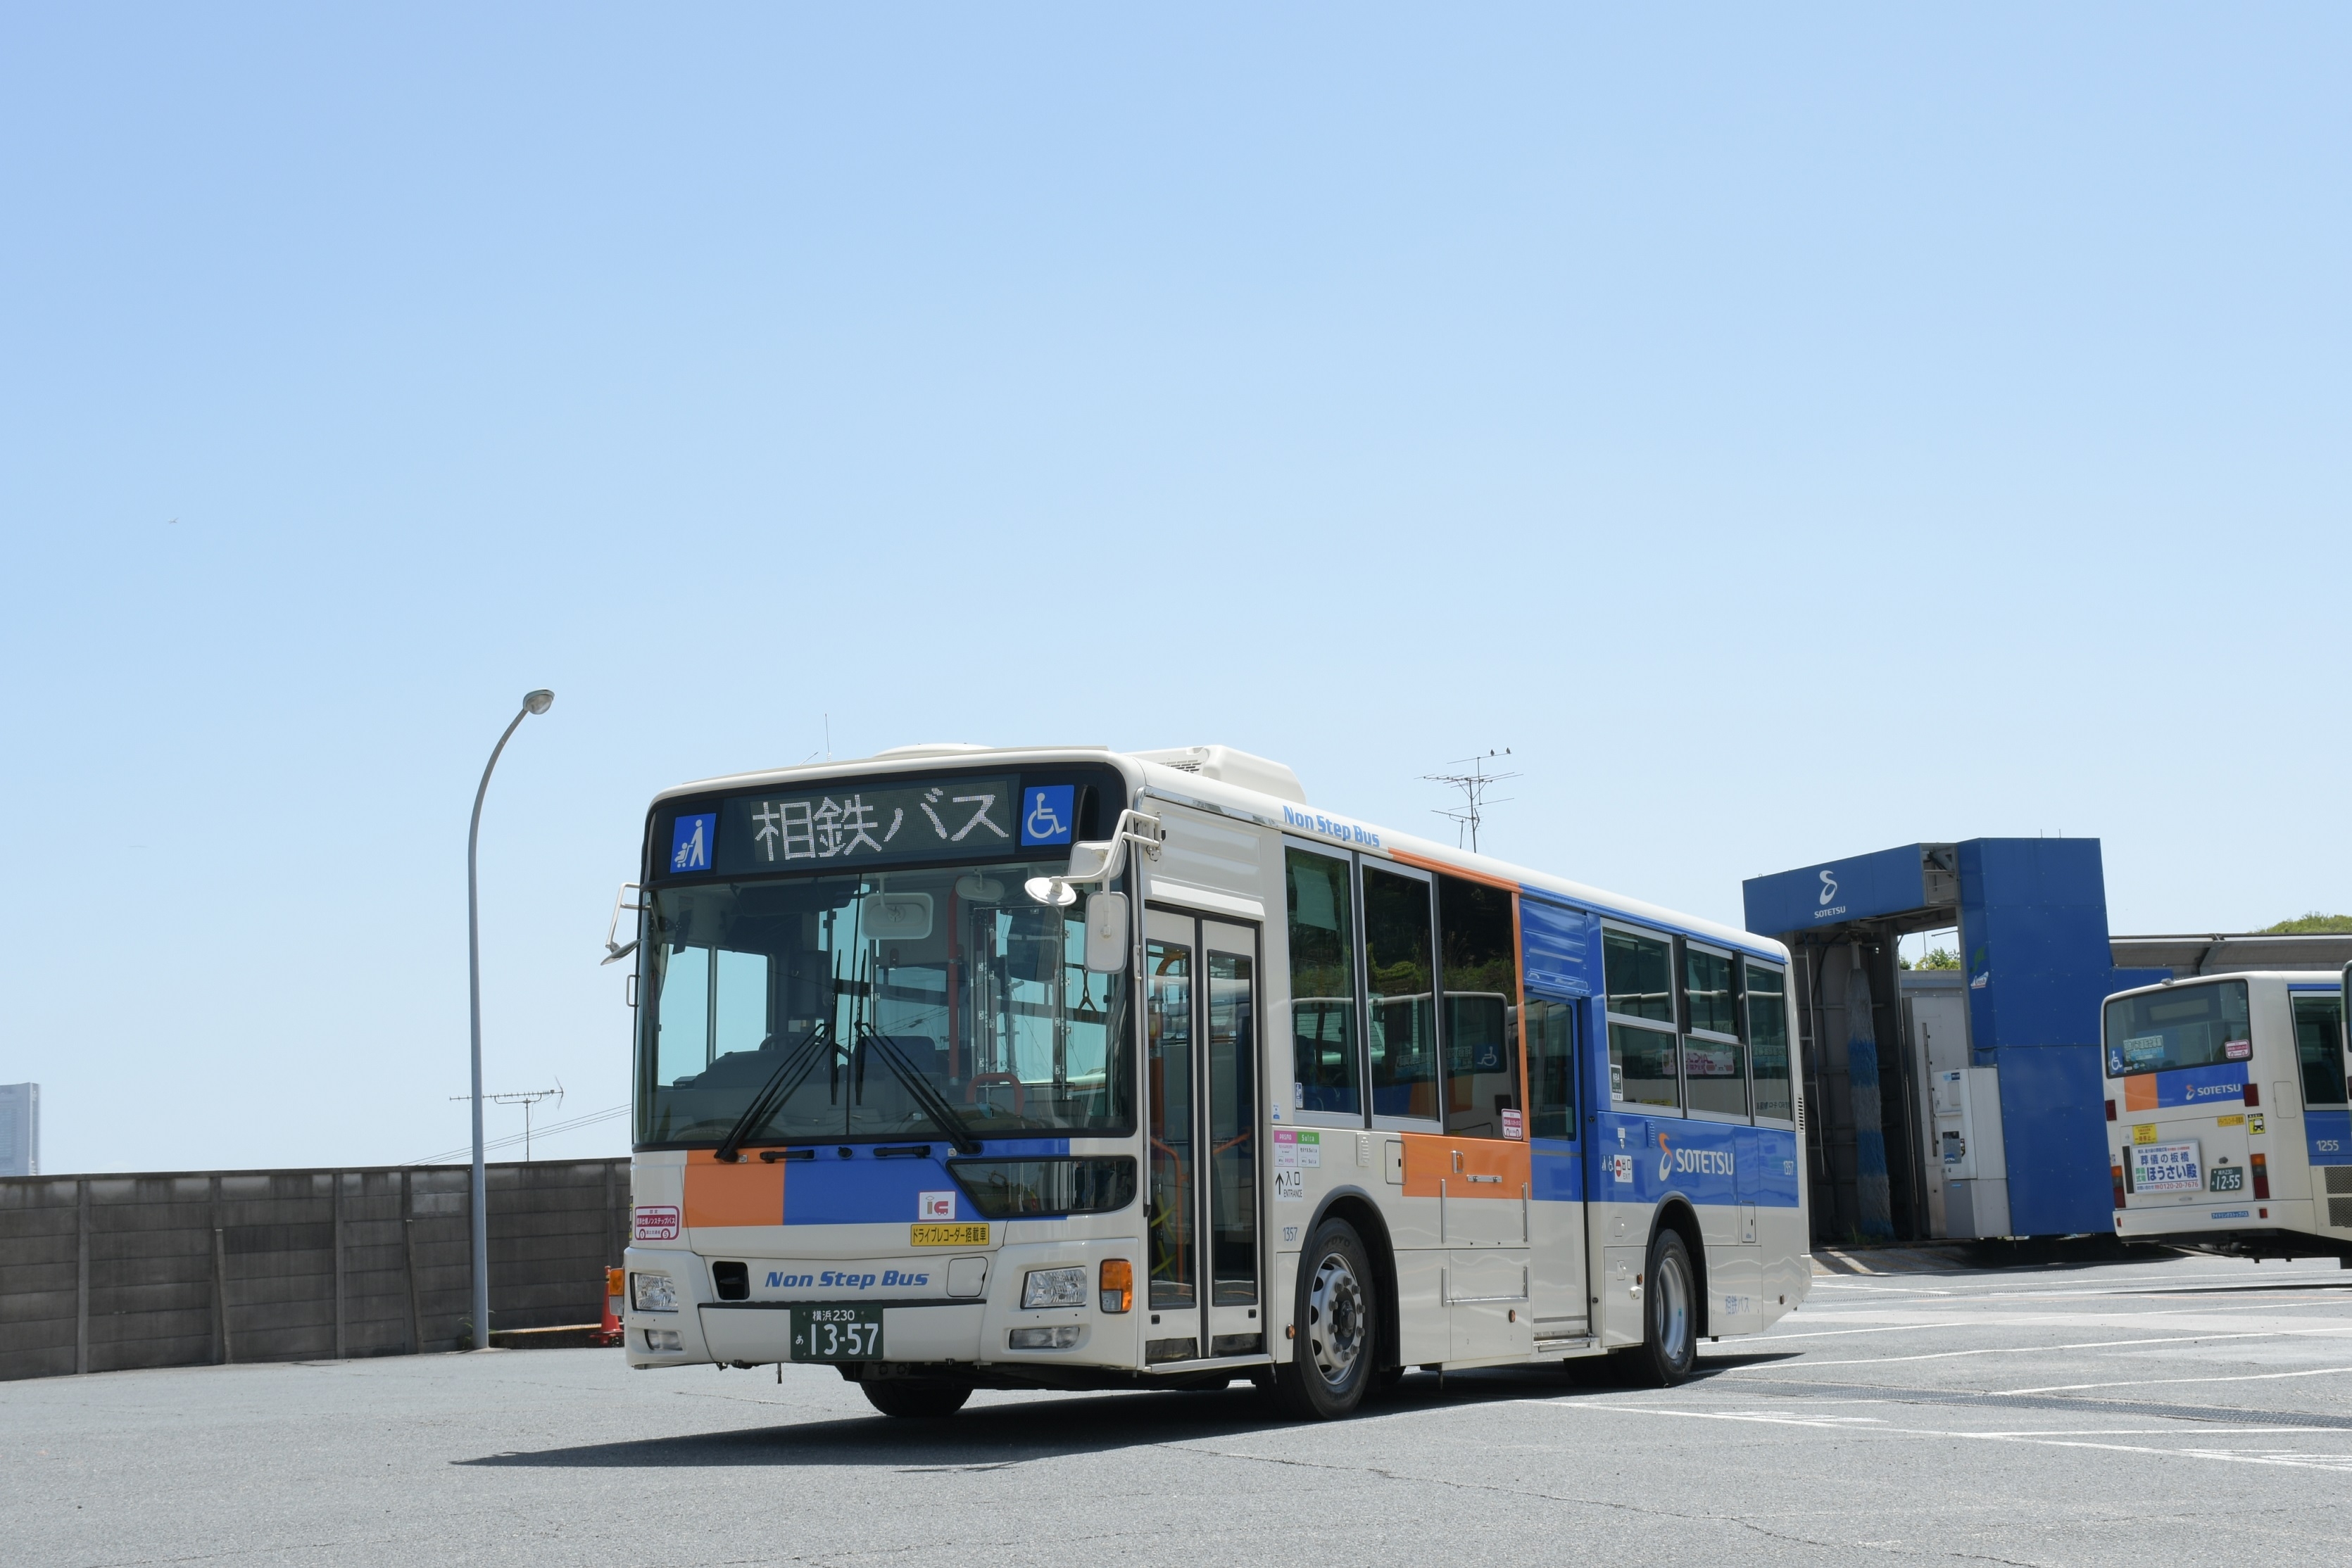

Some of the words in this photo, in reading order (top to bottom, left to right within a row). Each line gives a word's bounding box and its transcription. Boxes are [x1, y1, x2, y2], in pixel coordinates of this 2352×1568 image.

[753, 788, 1009, 861] 相鉄バス
[1283, 805, 1314, 830] Non
[1316, 815, 1351, 842] Step
[1353, 825, 1380, 847] Bus
[1814, 906, 1846, 918] SOTETSU
[2198, 1084, 2241, 1096] SOTETSU
[2316, 1140, 2339, 1151] 1255
[1621, 1158, 1631, 1171] 出口
[1675, 1148, 1734, 1175] SOTETSU
[2140, 1151, 2189, 1165] 葬儀の板橋
[1783, 1161, 1794, 1176] 1357
[2146, 1163, 2197, 1181] ほうさい殿
[1285, 1171, 1300, 1186] 入口
[2160, 1182, 2199, 1190] 0120-20-7676
[1283, 1189, 1302, 1198] ENTRANCE
[913, 1227, 986, 1243] ドライブレコーダー搭載車
[1283, 1227, 1298, 1241] 1357
[1325, 1237, 1351, 1248] TOYO
[765, 1272, 814, 1287] Non
[819, 1271, 876, 1289] Step
[881, 1270, 930, 1286] Bus
[1725, 1295, 1750, 1315] 相鉄バス
[795, 1334, 804, 1346] あ
[811, 1323, 879, 1355] 13-57
